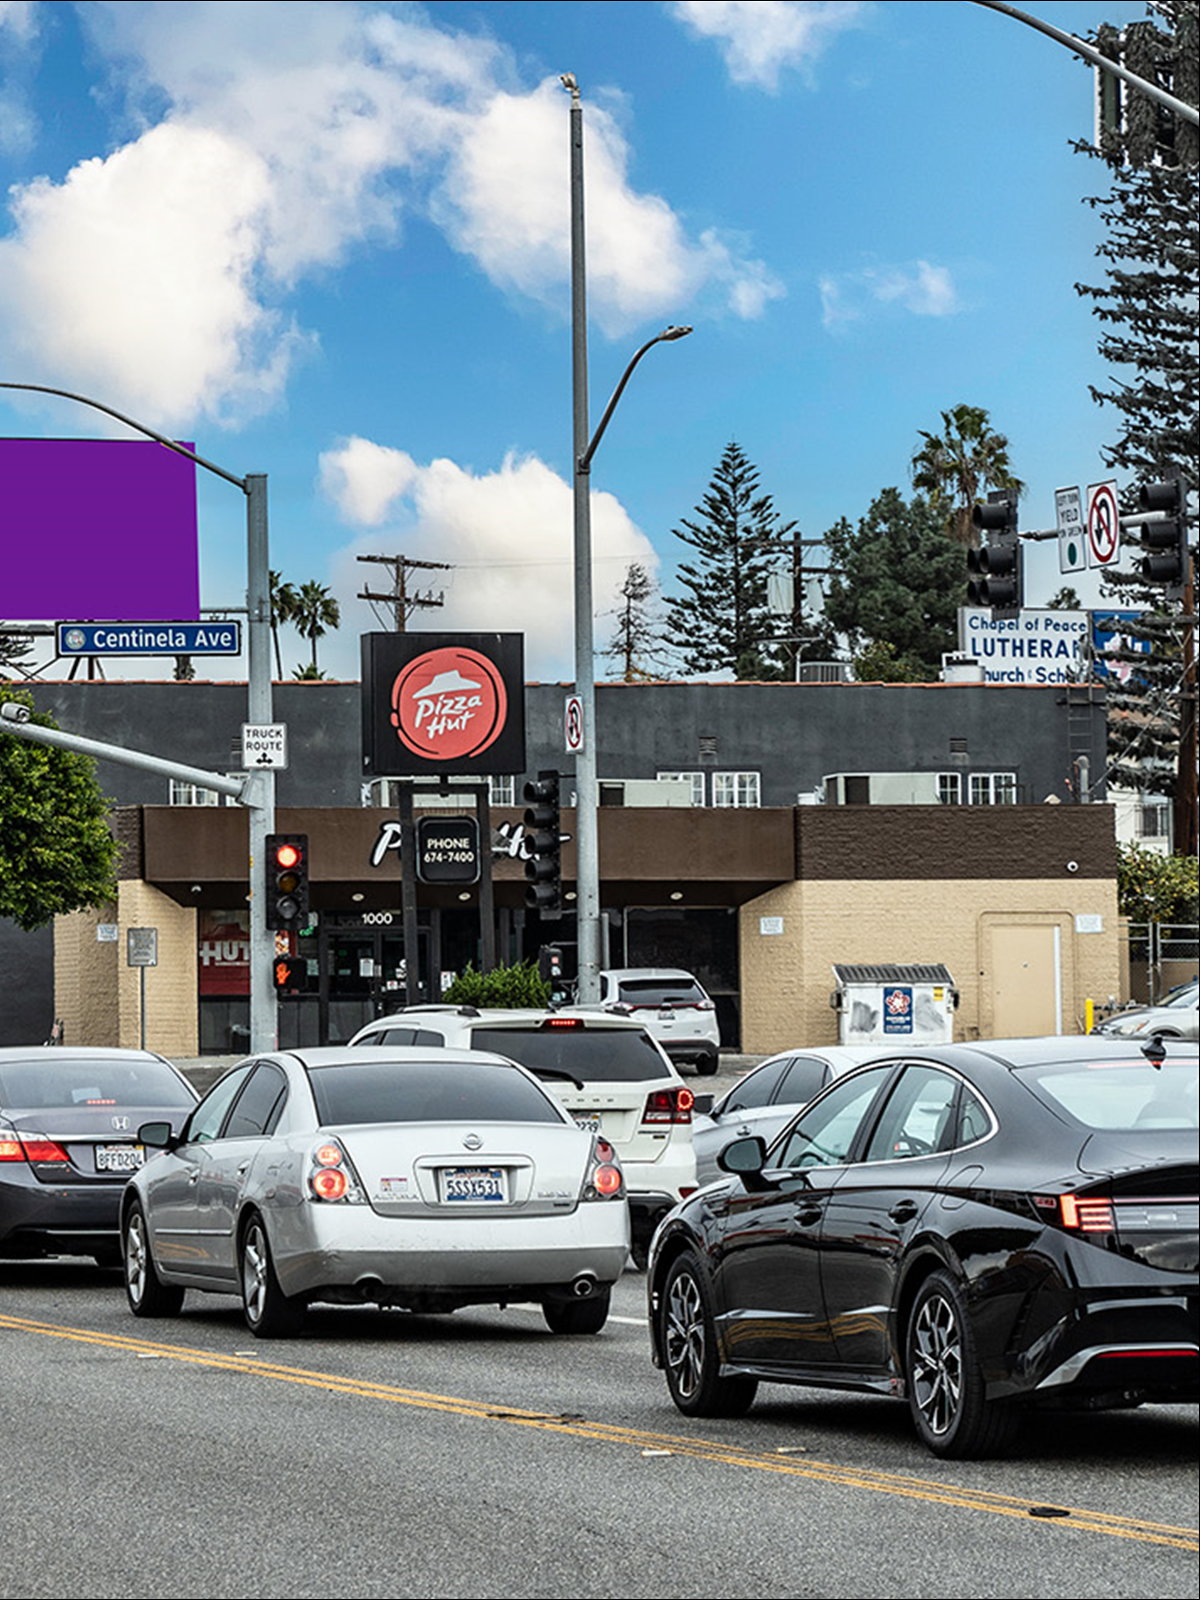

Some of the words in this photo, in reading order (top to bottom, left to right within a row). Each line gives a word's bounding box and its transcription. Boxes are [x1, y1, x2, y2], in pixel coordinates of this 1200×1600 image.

[1060, 508, 1078, 523] YIELD
[968, 615, 1020, 633] Chapel
[1025, 617, 1039, 630] of
[1044, 619, 1087, 632] Peace
[93, 629, 186, 648] Centinela
[194, 630, 232, 647] Ave
[983, 667, 1025, 682] hurch
[415, 694, 483, 728] Pizza
[426, 711, 476, 739] Hut
[246, 729, 283, 738] TRUCK
[246, 741, 282, 751] ROUTE
[427, 838, 470, 849] PHONE
[423, 852, 474, 863] 674-7400
[361, 912, 393, 924] 1000
[200, 941, 250, 966] HUT
[447, 1180, 499, 1196] 5SSX531
